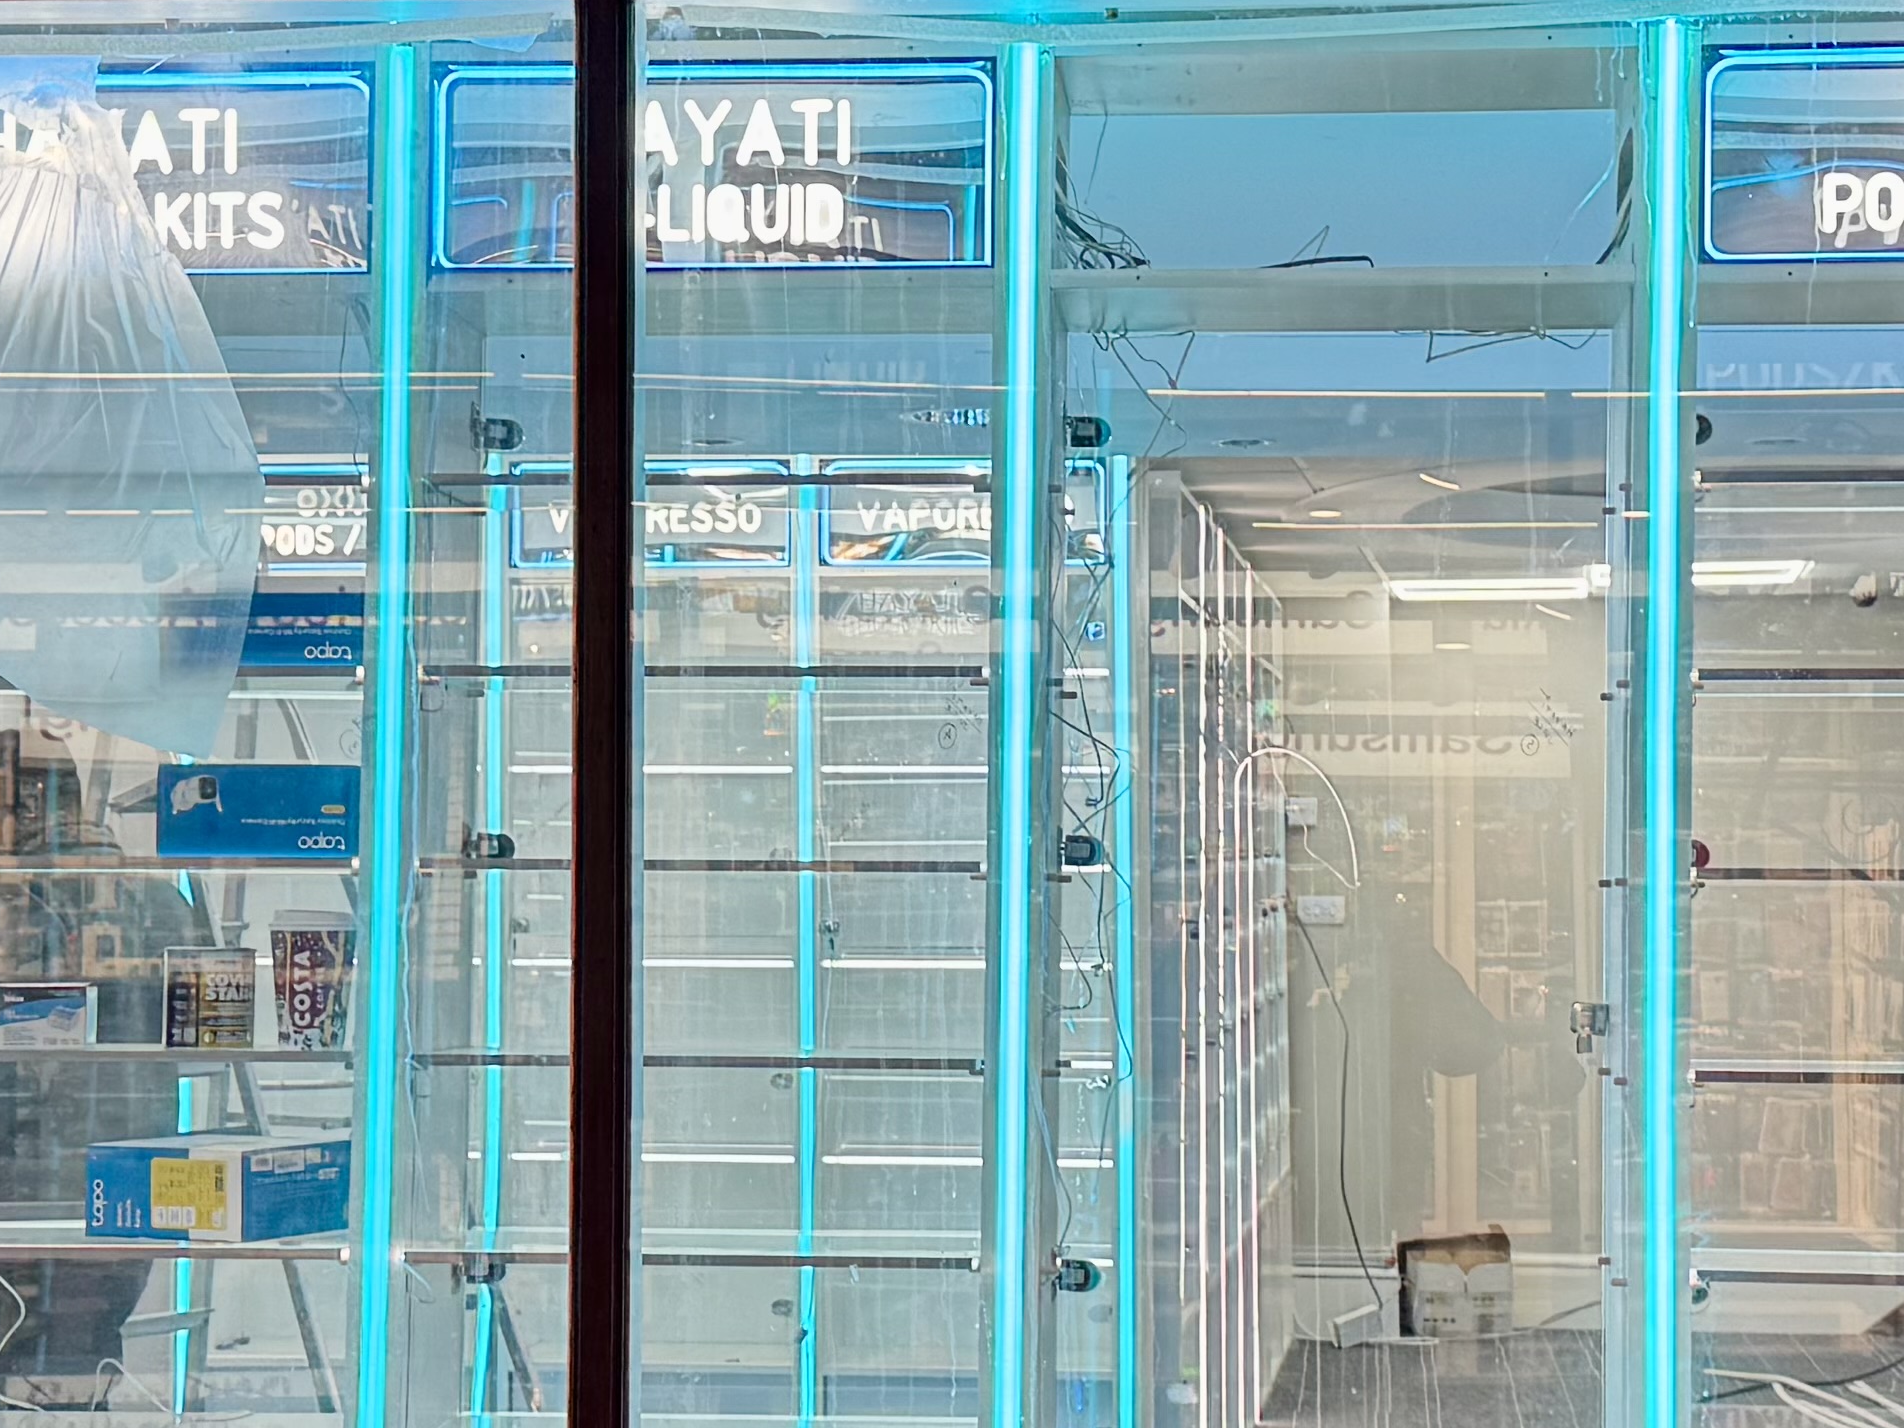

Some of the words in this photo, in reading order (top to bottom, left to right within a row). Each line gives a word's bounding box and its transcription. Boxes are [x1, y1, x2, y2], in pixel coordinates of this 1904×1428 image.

[644, 98, 852, 167] AYATI
[154, 190, 286, 251] KITS
[548, 500, 764, 535] VRESSO
[303, 641, 352, 660] tapo
[297, 831, 346, 851] tapo
[293, 949, 312, 1027] COSTA
[91, 1178, 107, 1228] tapo
